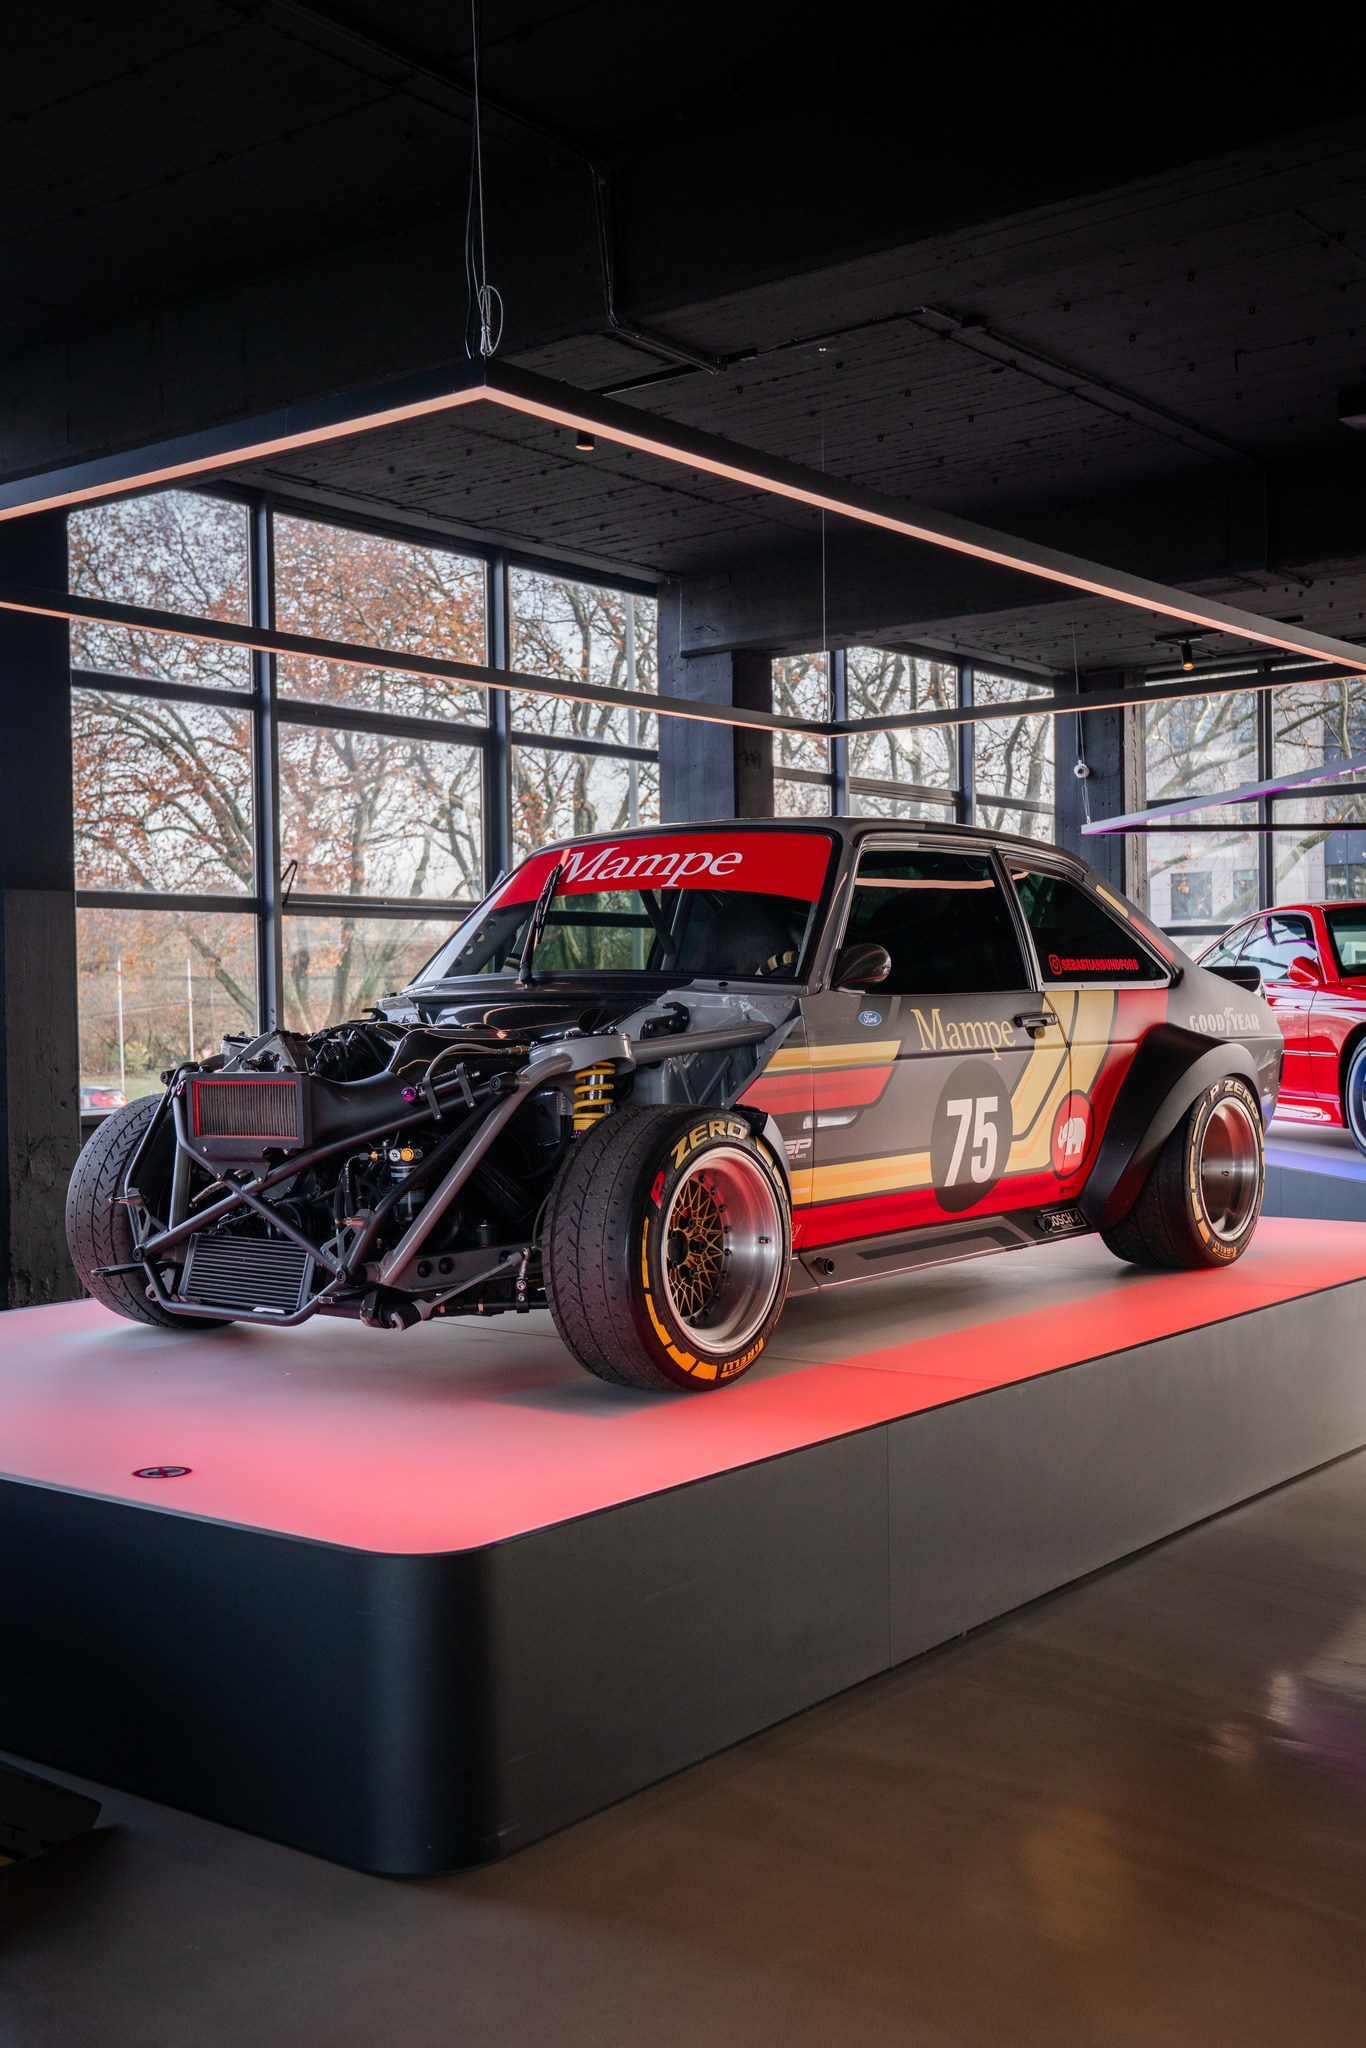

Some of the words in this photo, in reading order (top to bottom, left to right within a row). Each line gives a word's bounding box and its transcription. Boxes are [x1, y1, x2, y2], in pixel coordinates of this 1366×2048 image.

[558, 846, 744, 888] Mampe
[910, 1008, 1017, 1061] Mampe
[1189, 1007, 1260, 1037] GOODYEAR
[1224, 1080, 1260, 1120] ZERO
[944, 1096, 999, 1187] 75
[650, 1170, 665, 1210] P
[670, 1120, 748, 1170] ZERO
[1050, 1212, 1075, 1227] OSCH
[720, 1336, 765, 1378] PIRELLI
